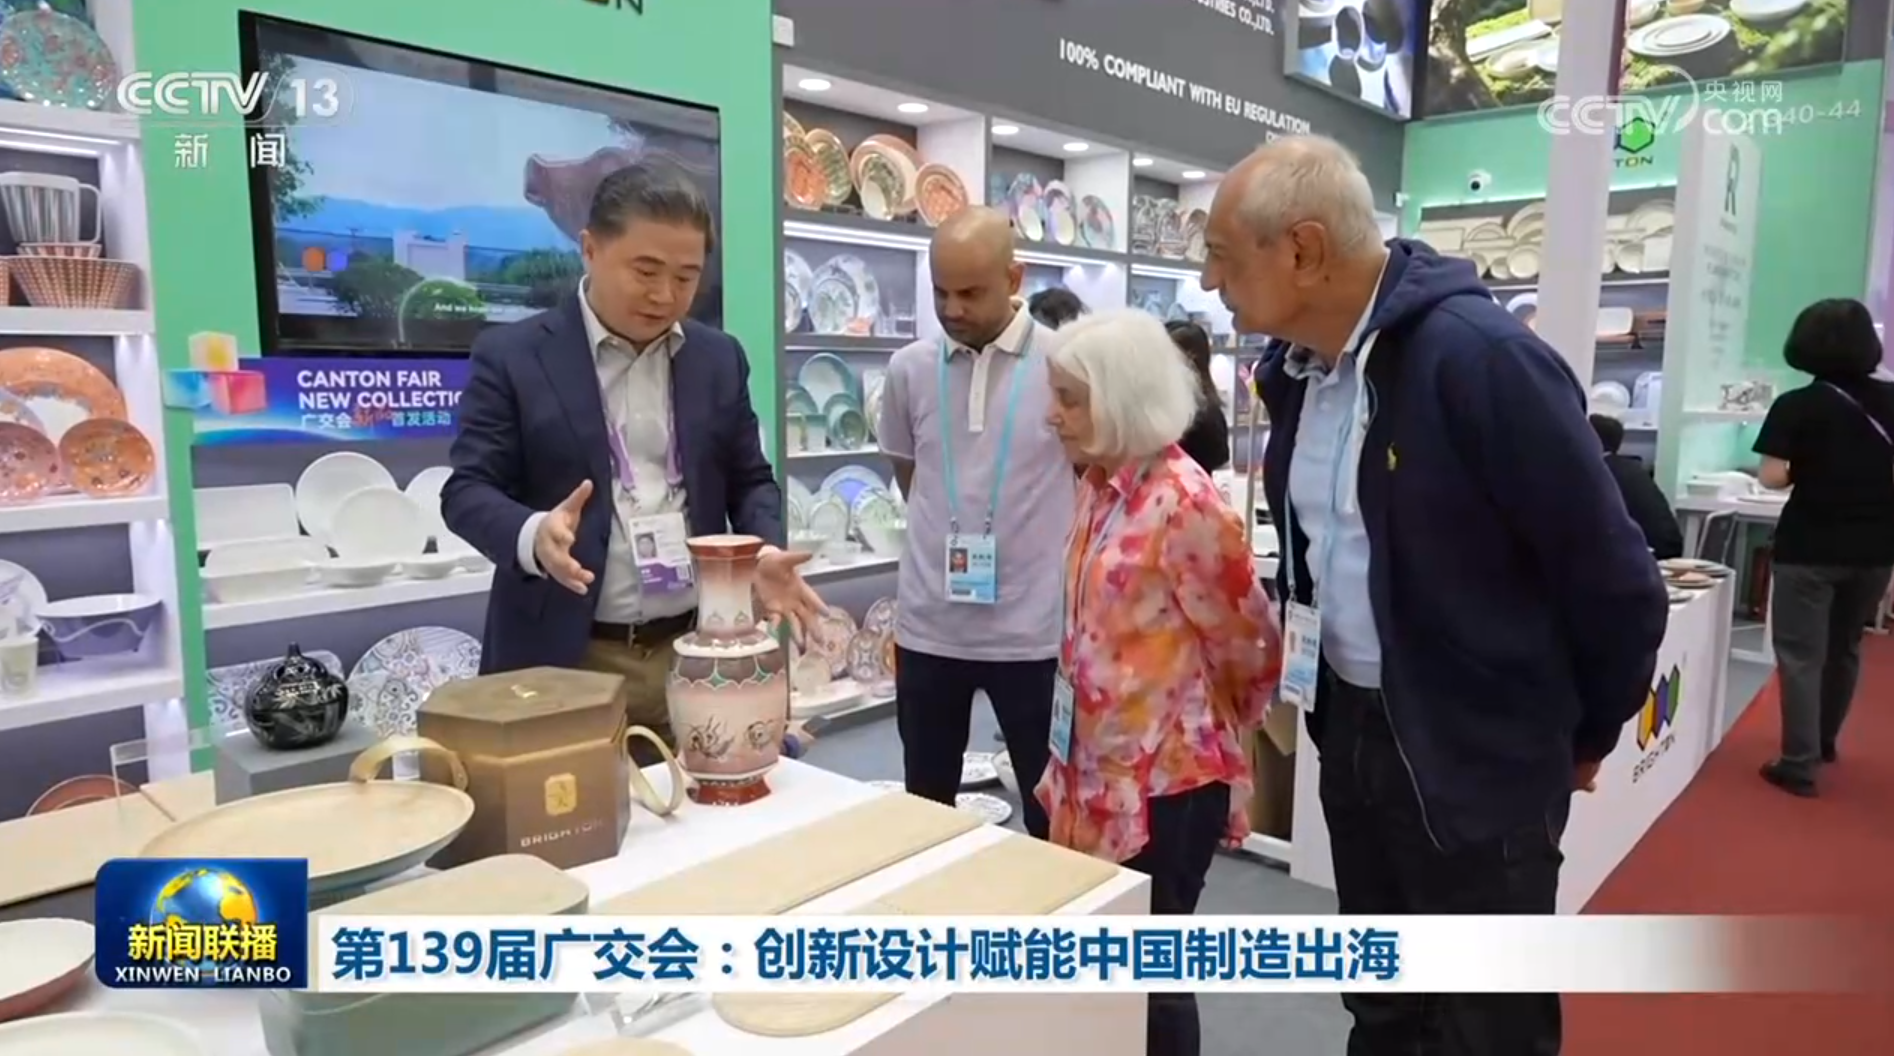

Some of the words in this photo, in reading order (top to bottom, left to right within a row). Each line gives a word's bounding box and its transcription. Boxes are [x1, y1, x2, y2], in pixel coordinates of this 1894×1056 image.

[1060, 38, 1099, 71] 100%
[1103, 53, 1186, 99] COMPLIANT
[1188, 82, 1223, 111] WITH
[1224, 94, 1242, 116] EU
[1243, 100, 1311, 134] REGULATION
[297, 370, 392, 388] CANTON
[397, 370, 442, 387] FAIR
[298, 391, 352, 410] NEW
